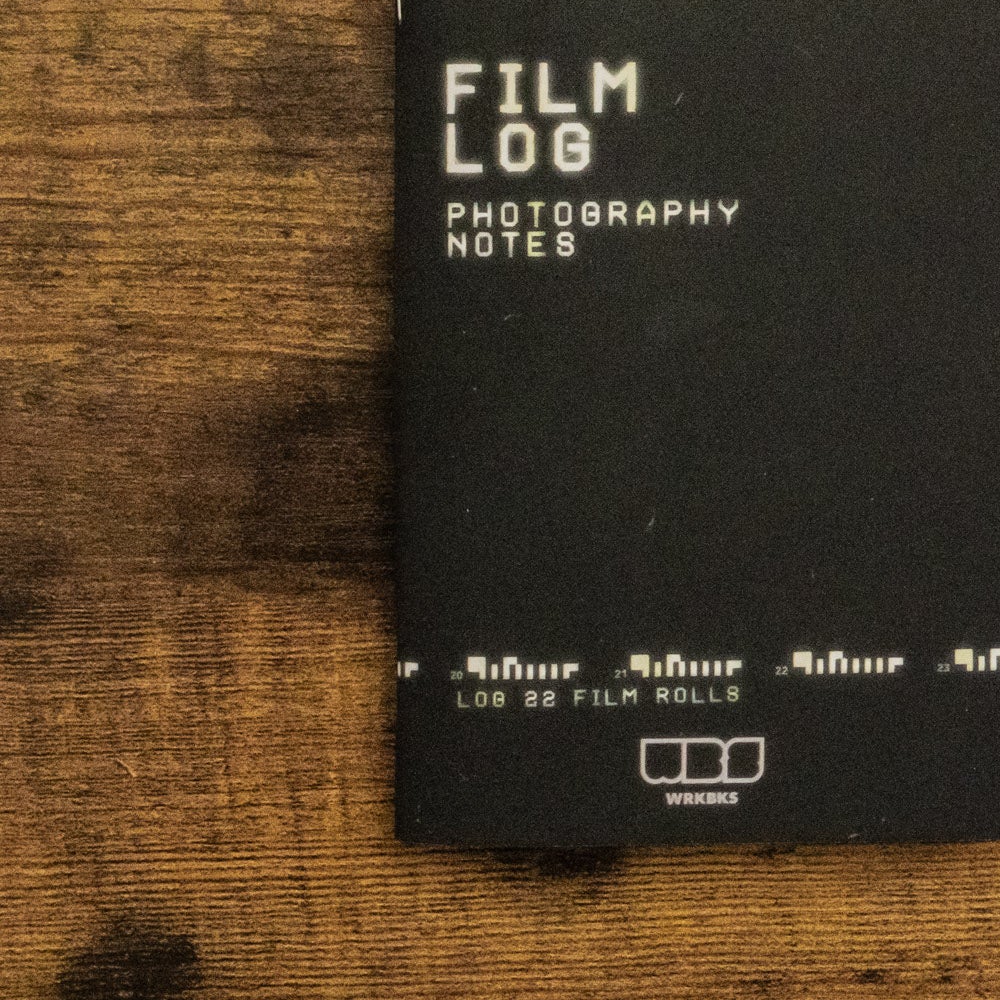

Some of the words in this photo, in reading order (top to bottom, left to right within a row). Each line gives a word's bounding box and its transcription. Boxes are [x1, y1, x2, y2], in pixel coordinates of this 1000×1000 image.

[446, 61, 638, 114] FILM
[445, 122, 590, 174] LOG
[447, 200, 740, 228] PHOTOGRAPHY
[447, 231, 576, 257] NOTES
[775, 666, 788, 676] 22
[457, 691, 506, 708] LOG
[524, 690, 556, 708] 22
[573, 688, 638, 707] FILM
[655, 685, 741, 705] ROLLS
[666, 792, 739, 805] WRKBKS
